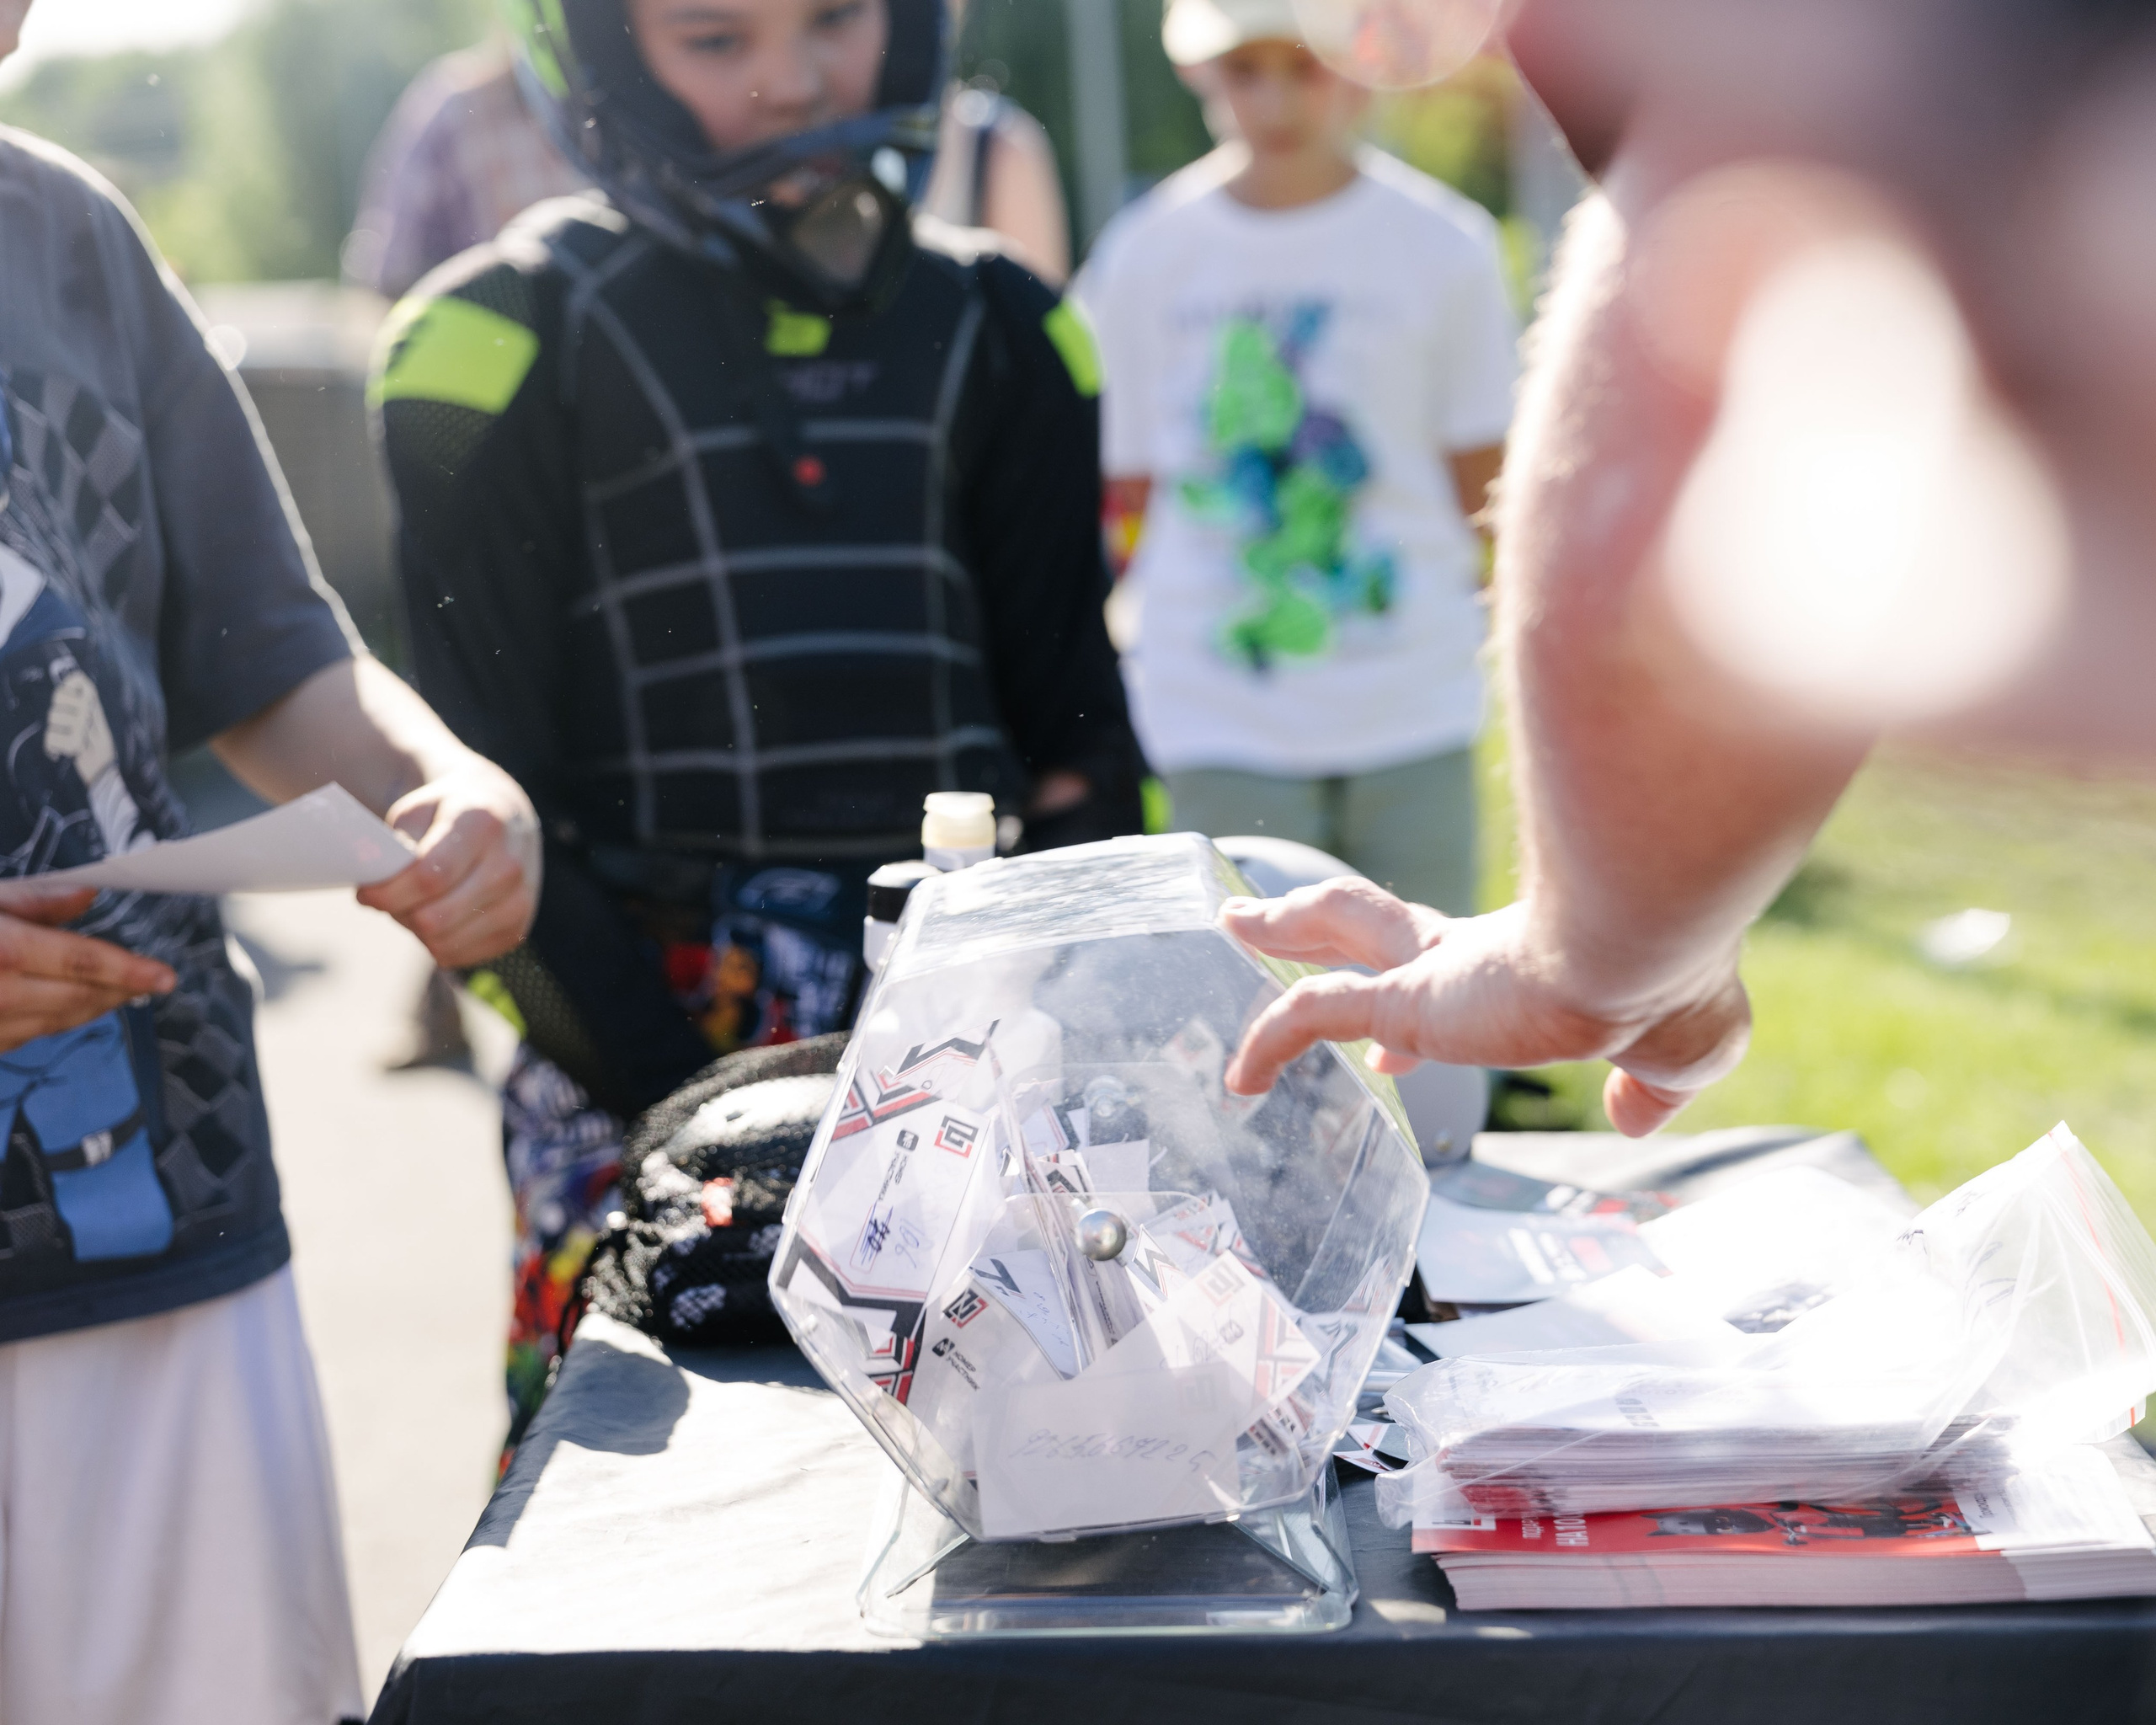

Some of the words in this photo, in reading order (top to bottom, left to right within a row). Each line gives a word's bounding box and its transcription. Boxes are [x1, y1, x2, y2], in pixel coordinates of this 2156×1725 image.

[946, 1354, 981, 1391] УЧАСТНИК
[953, 1351, 977, 1373] НОМЕР
[1521, 1515, 1545, 1540] ПОДАР
